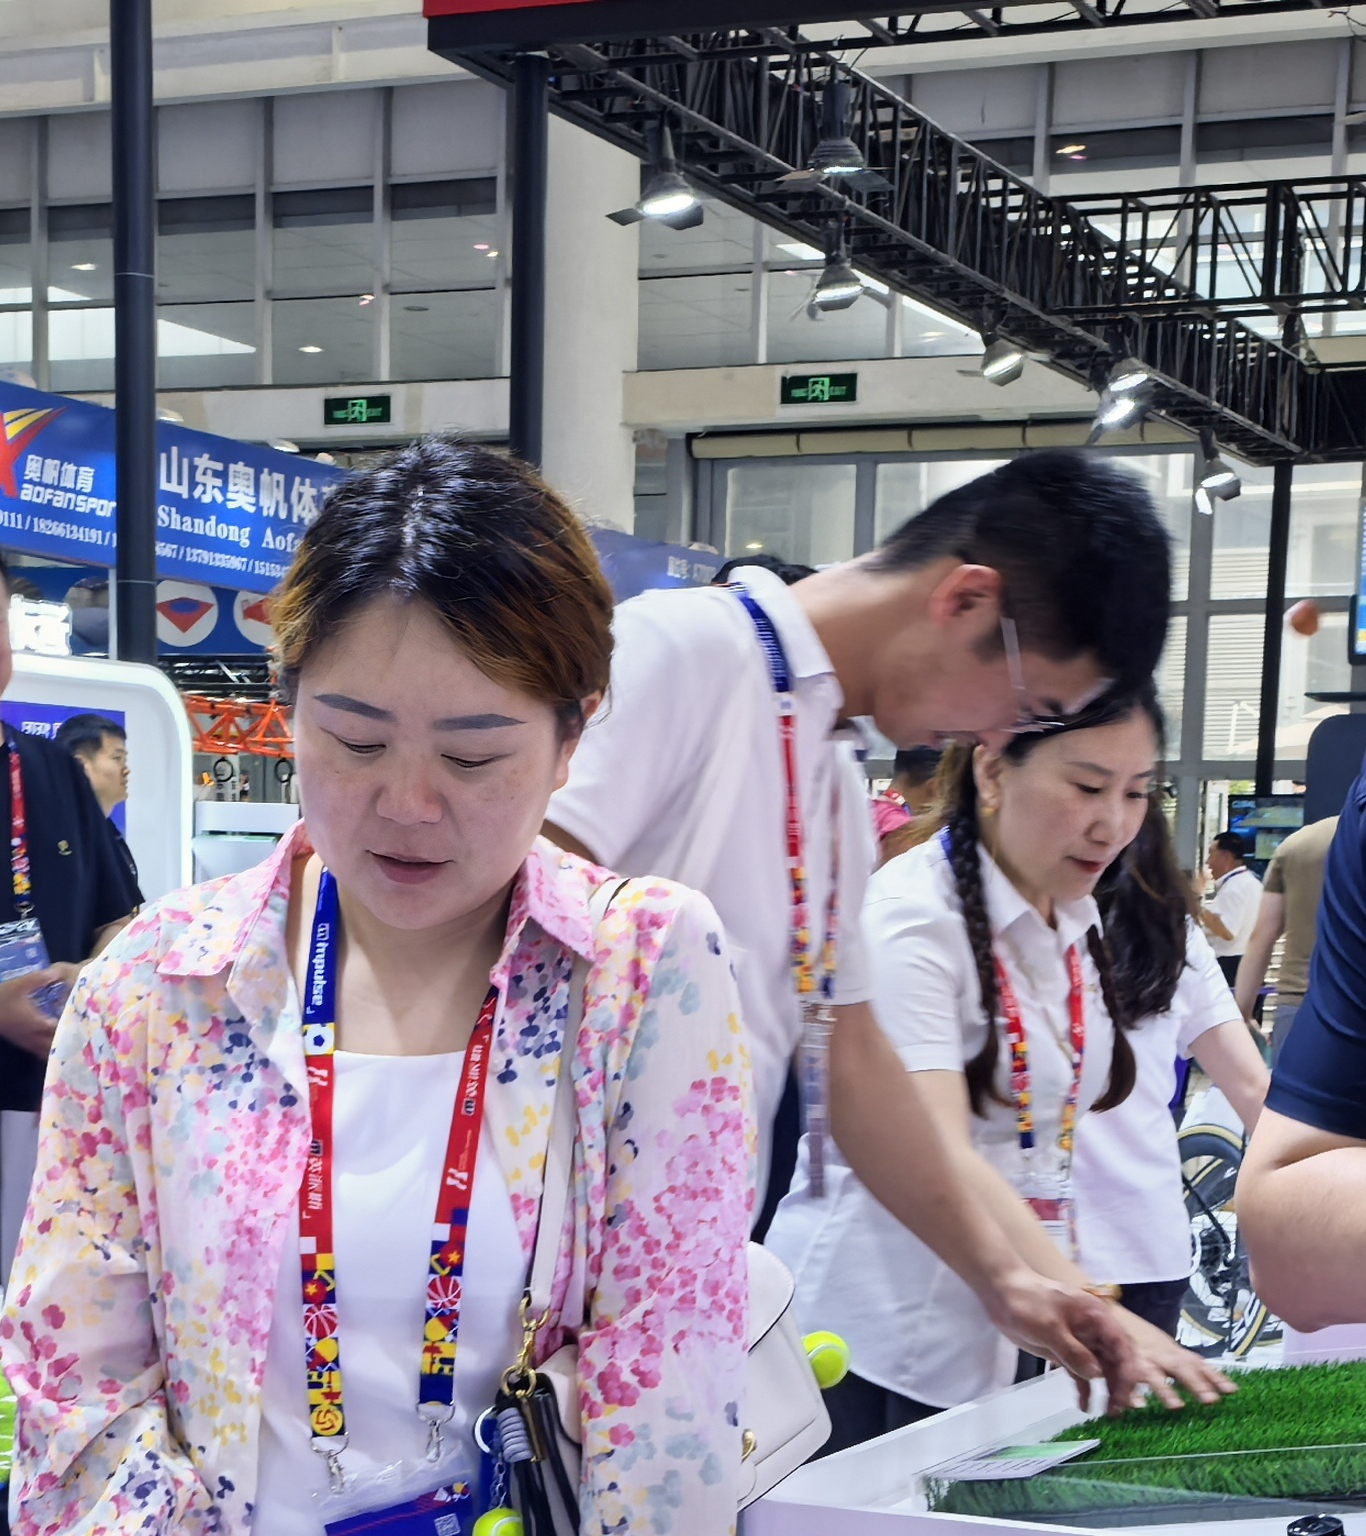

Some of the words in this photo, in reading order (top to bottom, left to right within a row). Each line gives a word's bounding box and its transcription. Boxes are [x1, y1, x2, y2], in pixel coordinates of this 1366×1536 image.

[23, 454, 96, 493] 奥帆体育
[157, 504, 251, 548] Shandong
